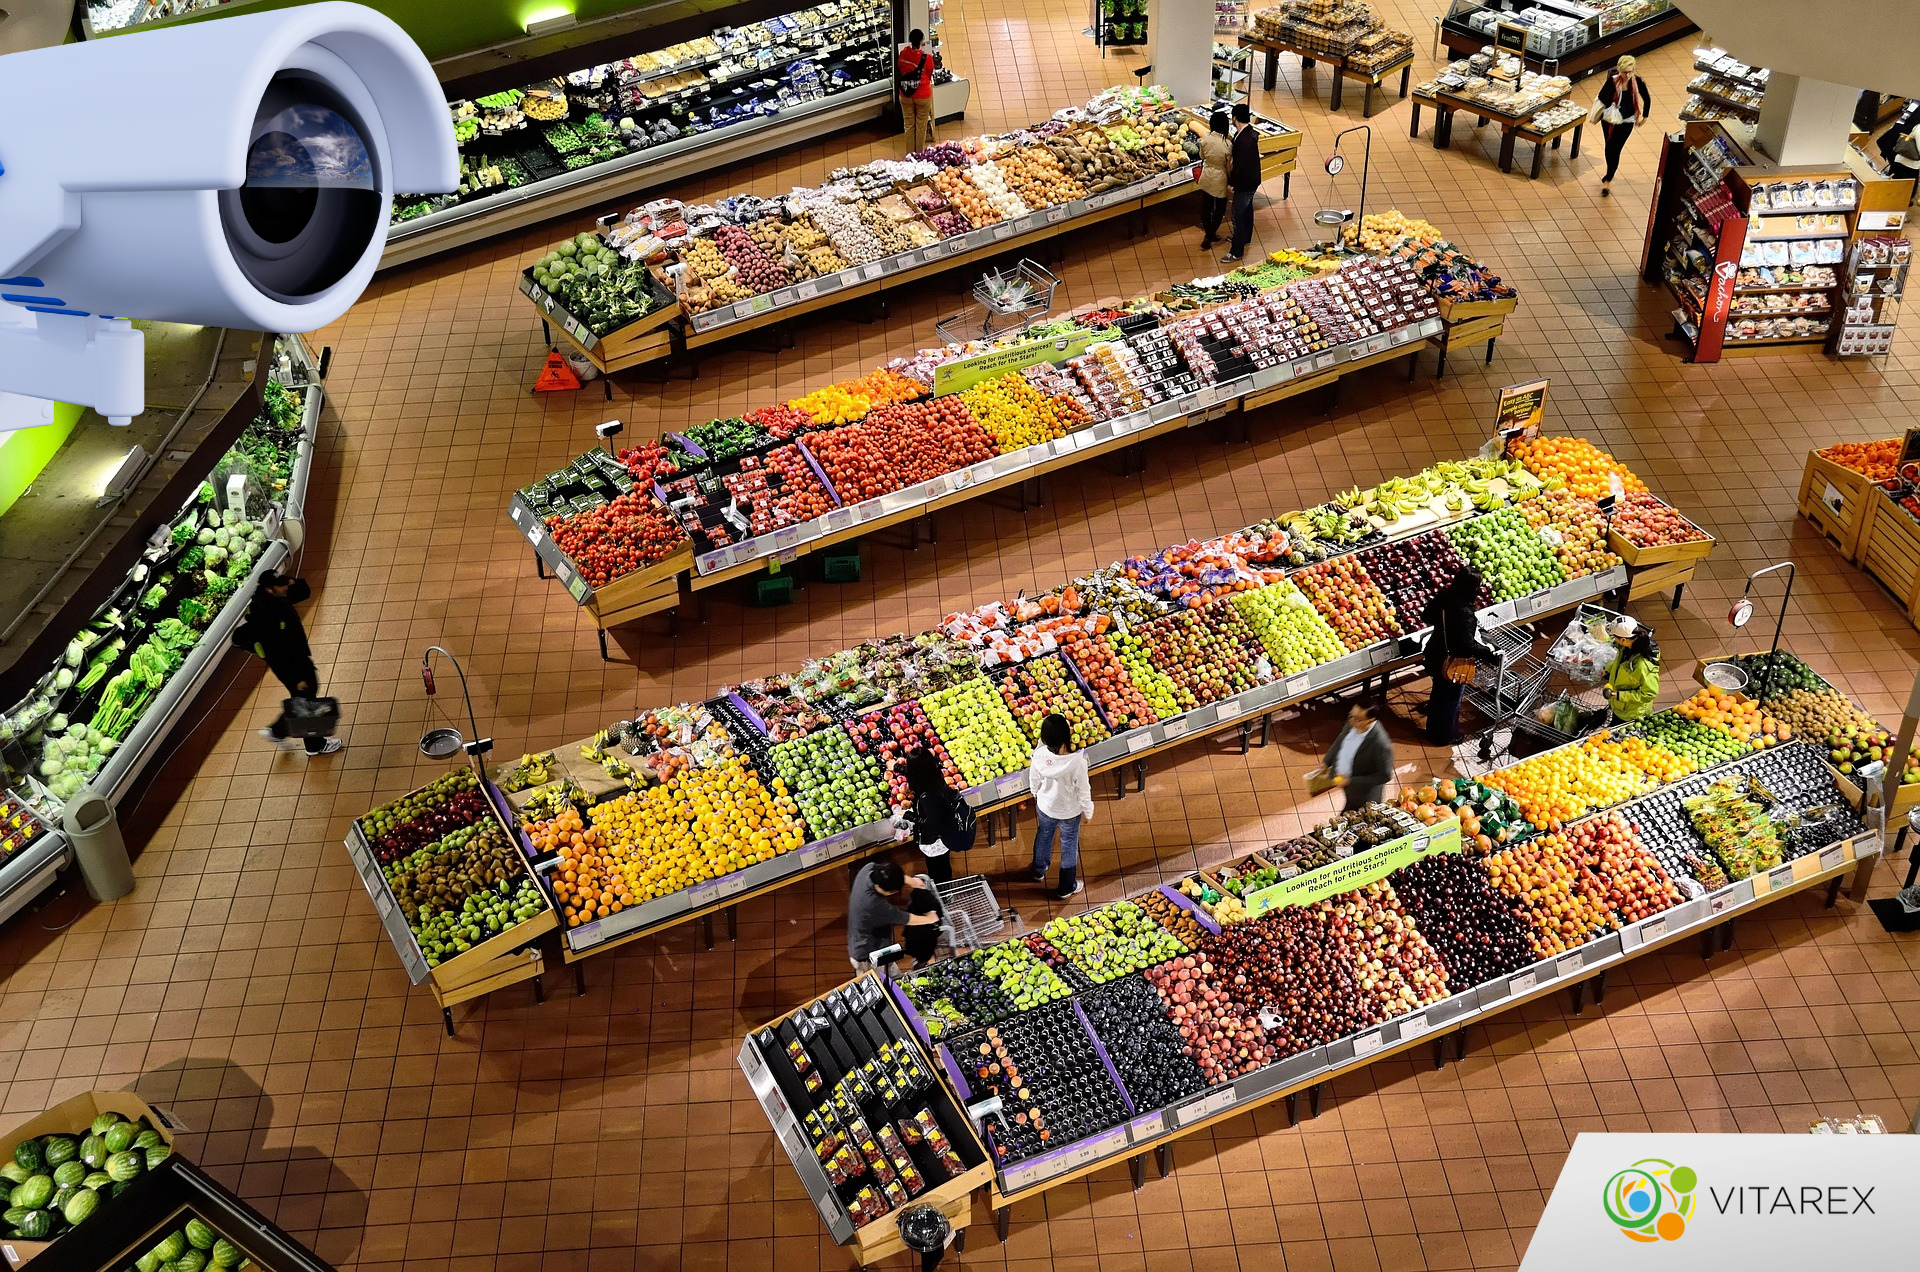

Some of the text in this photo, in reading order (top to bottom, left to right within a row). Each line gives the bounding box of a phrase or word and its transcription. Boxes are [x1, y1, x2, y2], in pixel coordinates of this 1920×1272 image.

[1714, 261, 1734, 322] Vachon
[963, 358, 987, 369] Looking
[997, 350, 1026, 361] nutritious
[1028, 342, 1053, 353] choices?
[979, 362, 997, 371] Reach
[1019, 352, 1037, 361] Stars!
[1285, 876, 1318, 893] Looking
[1319, 872, 1331, 882] for
[1333, 857, 1372, 876] nutritious
[1374, 842, 1408, 861] choices?
[1308, 880, 1333, 893] Reach
[1334, 875, 1346, 884] for
[1348, 869, 1362, 879] the
[1363, 859, 1388, 873] Stars!
